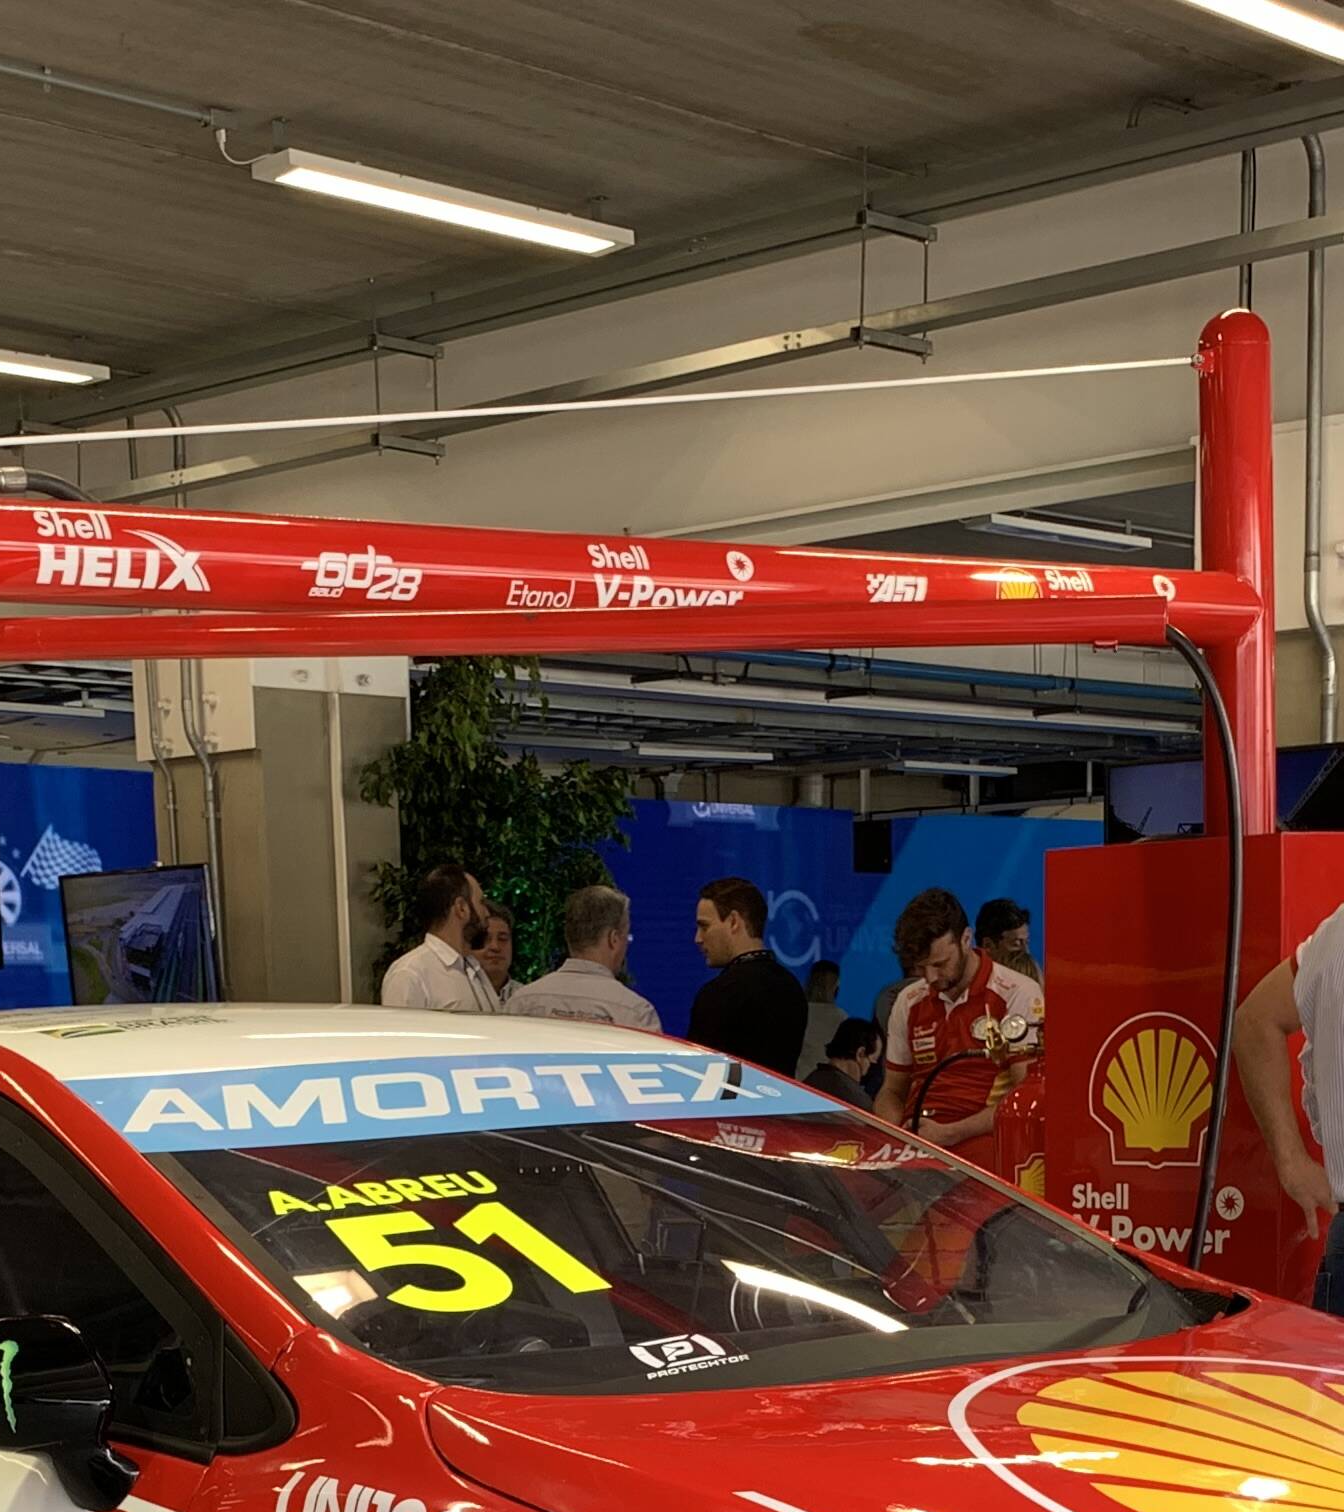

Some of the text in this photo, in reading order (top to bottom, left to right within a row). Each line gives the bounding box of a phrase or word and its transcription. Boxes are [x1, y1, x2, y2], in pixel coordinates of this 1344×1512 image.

[32, 510, 112, 540] Shell
[36, 530, 211, 592] HELIX
[587, 544, 650, 571] Shell
[507, 573, 744, 608] Etanol V-Power
[1045, 570, 1094, 593] Shell
[123, 1061, 761, 1133] AMORTEX
[267, 1170, 498, 1216] A.ABREU
[1072, 1182, 1130, 1210] Shell
[326, 1202, 613, 1312] 51
[646, 1353, 750, 1380] PROTECHTOR
